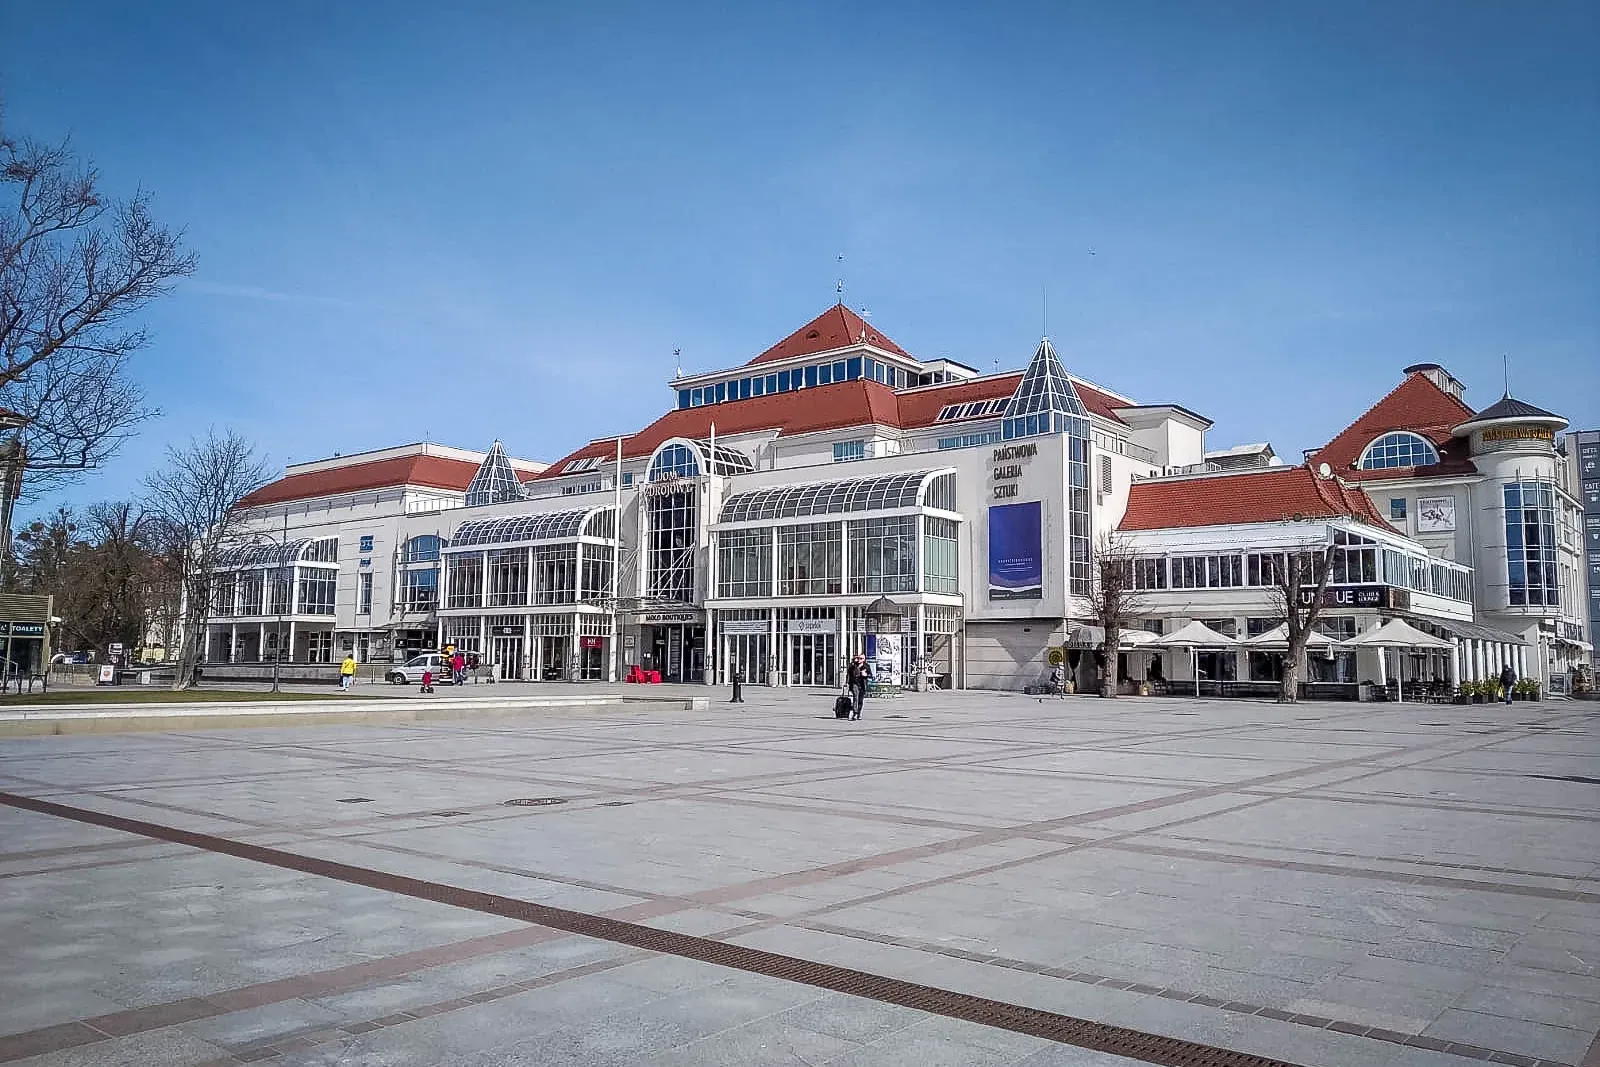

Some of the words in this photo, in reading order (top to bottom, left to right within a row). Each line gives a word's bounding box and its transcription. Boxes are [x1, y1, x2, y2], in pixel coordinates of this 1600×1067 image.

[993, 442, 1038, 462] PAŃSTWOWA
[993, 464, 1023, 480] GALERIA
[993, 483, 1019, 499] SZTUKI
[662, 613, 694, 621] BOUTIQUES
